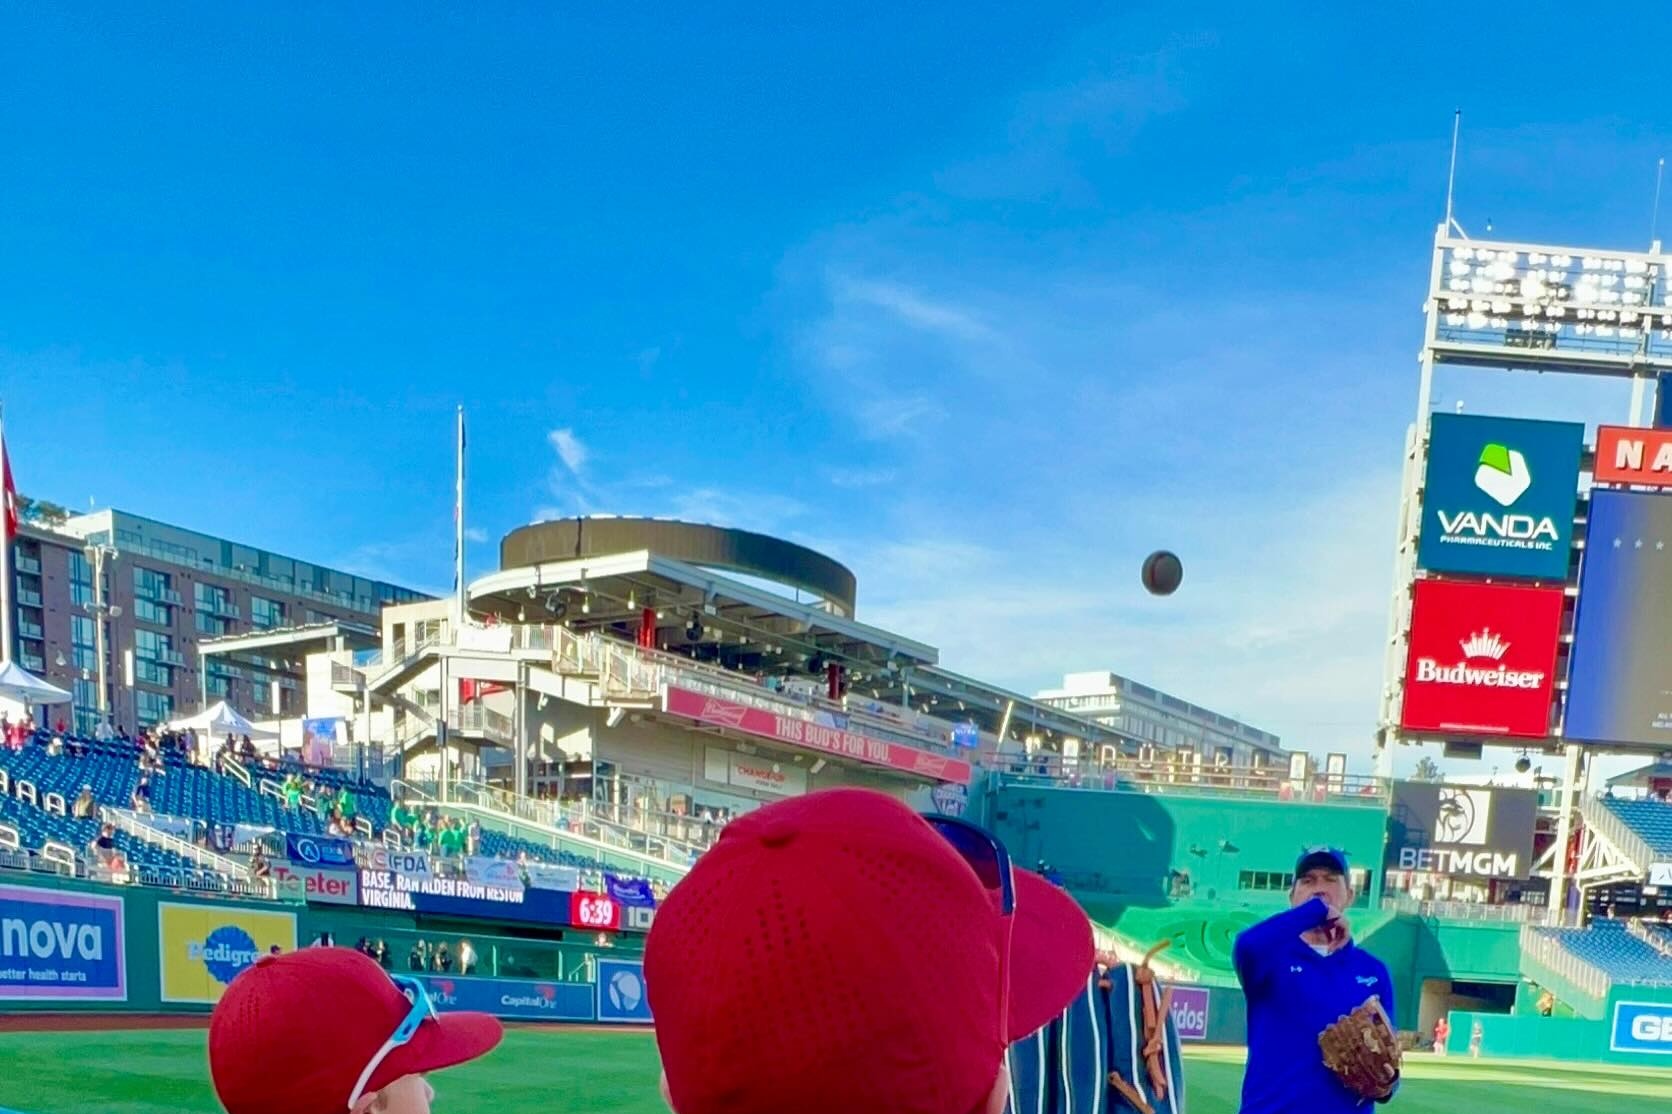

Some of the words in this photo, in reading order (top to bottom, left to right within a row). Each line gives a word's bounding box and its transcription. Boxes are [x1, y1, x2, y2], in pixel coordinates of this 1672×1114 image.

[1437, 510, 1559, 540] VANDA
[1440, 535, 1534, 549] PHARMACEUTICALS
[1416, 657, 1545, 689] Budweiser
[775, 716, 803, 740] THIS
[805, 724, 841, 750] BUD'S
[842, 734, 865, 757] FOR
[1400, 847, 1517, 876] BETMGM
[362, 870, 394, 890] BASE,
[579, 898, 613, 925] 6:39
[2, 918, 102, 960] nova
[28, 968, 59, 981] health
[61, 970, 87, 982] starts
